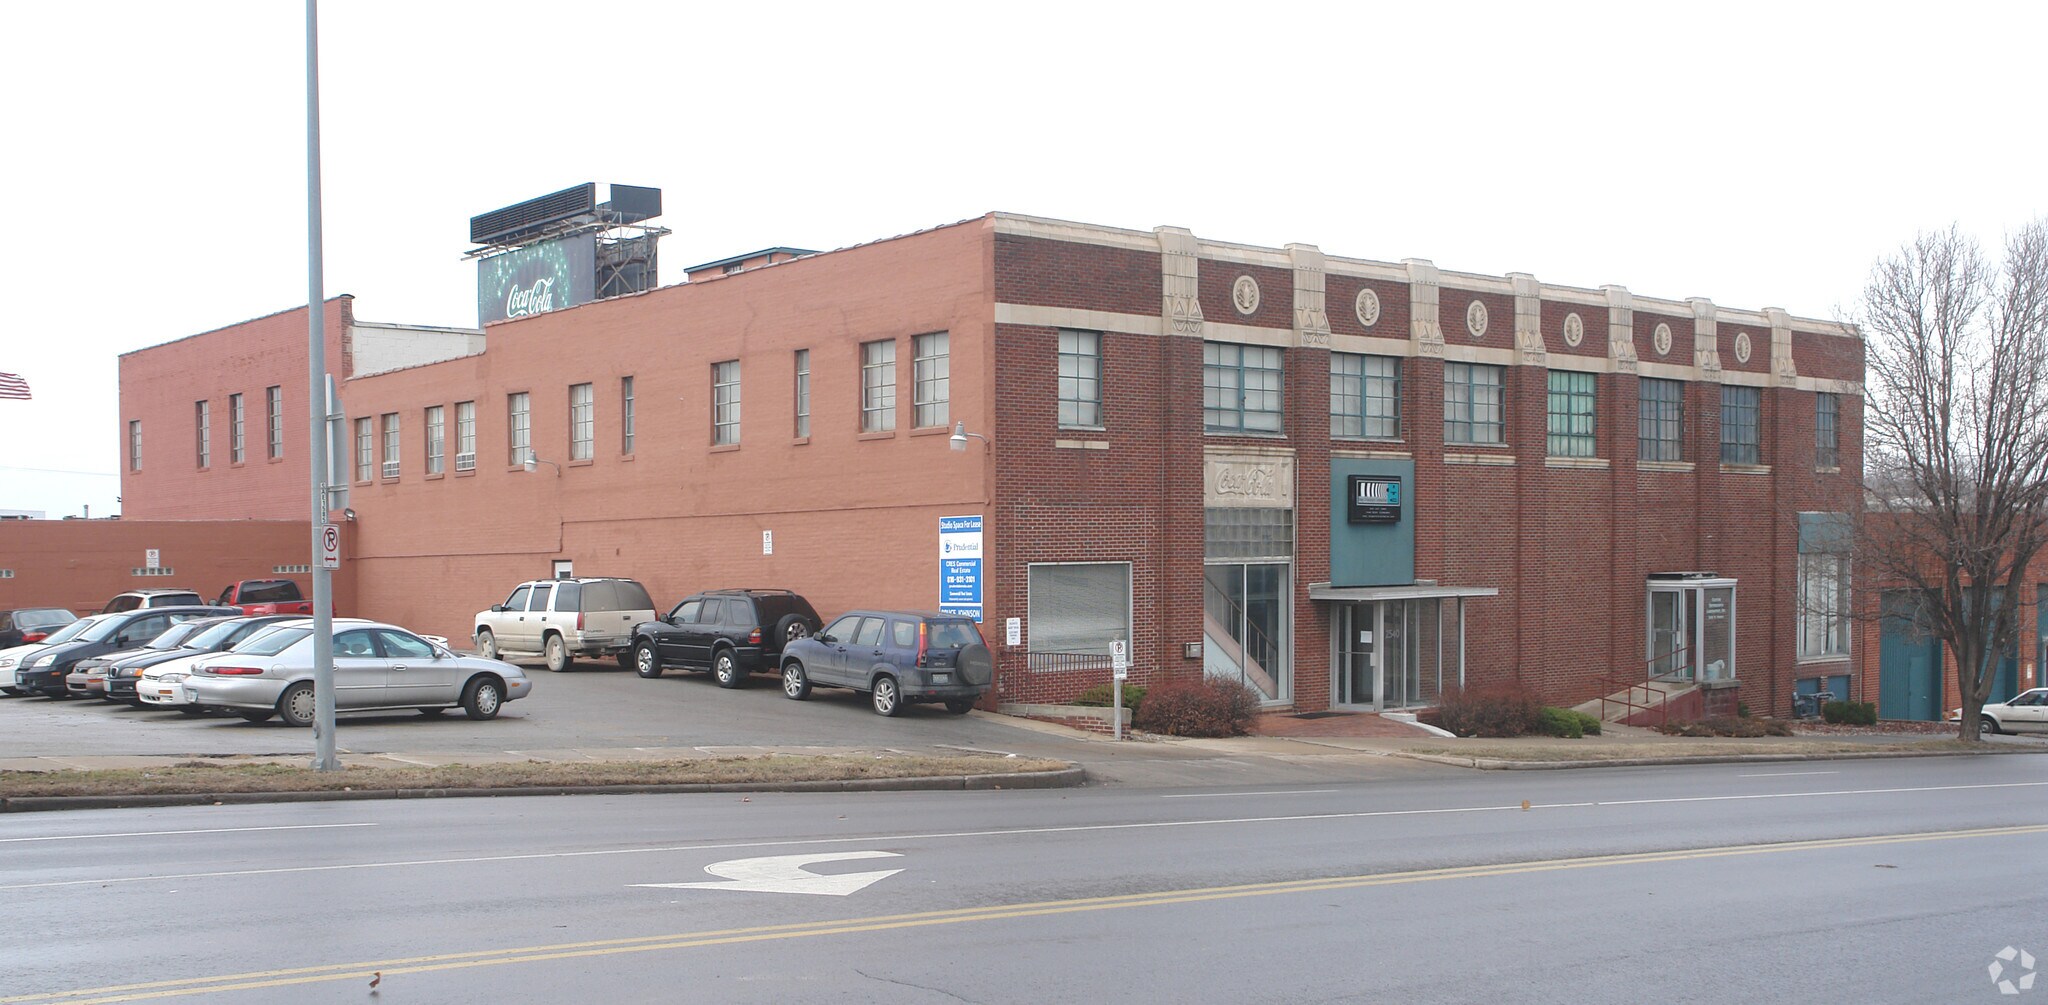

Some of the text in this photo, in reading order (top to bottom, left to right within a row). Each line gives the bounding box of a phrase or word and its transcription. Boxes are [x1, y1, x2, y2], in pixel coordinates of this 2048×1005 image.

[506, 277, 556, 318] Coca-Cola
[941, 521, 952, 530] Studio
[953, 521, 963, 531] Space
[971, 520, 981, 528] Lease
[953, 542, 978, 551] Prudential
